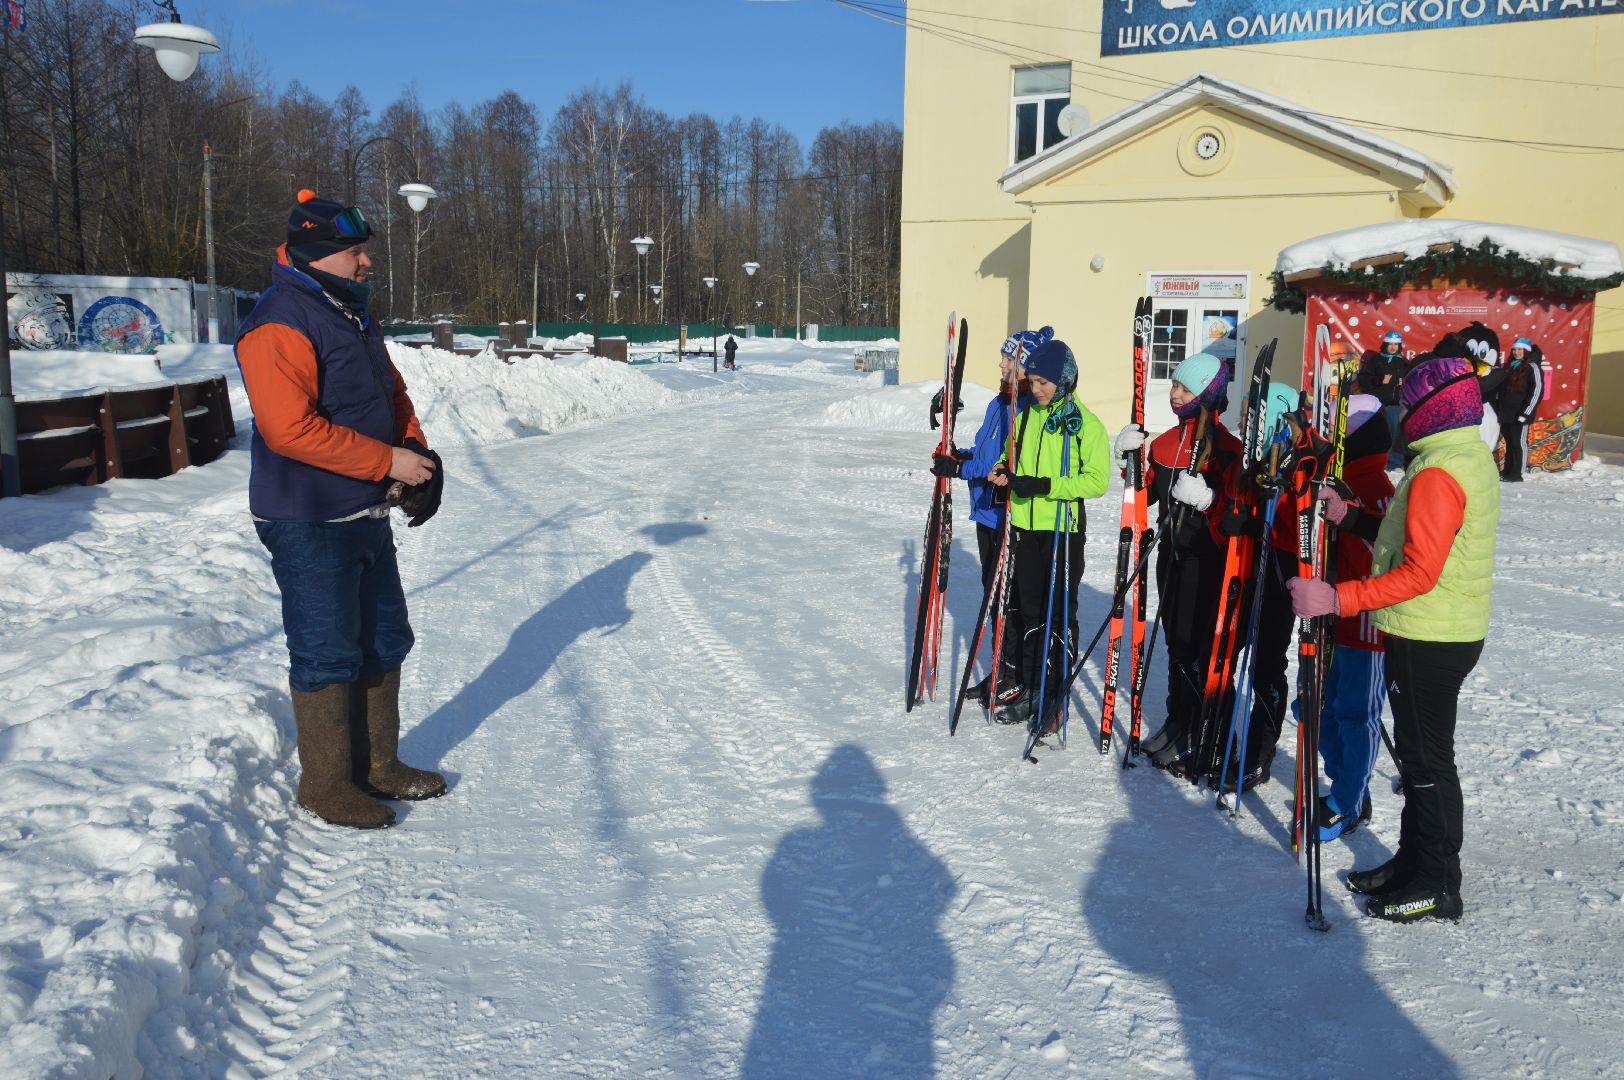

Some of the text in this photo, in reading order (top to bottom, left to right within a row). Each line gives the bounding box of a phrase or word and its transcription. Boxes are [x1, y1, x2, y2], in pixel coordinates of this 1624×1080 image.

[1118, 19, 1218, 49] ШКОЛА
[1226, 0, 1486, 39] ОЛИМПИЙСКОГО
[1163, 281, 1200, 291] ЮЖНЫЙ
[1408, 305, 1445, 315] ЗИМА
[1134, 346, 1145, 426] BRADOS
[1335, 396, 1349, 480] SCHER
[1109, 649, 1120, 688] SKATE
[1102, 690, 1116, 735] PRO
[1101, 739, 1109, 755] 173
[1384, 897, 1435, 916] NORDWAY
